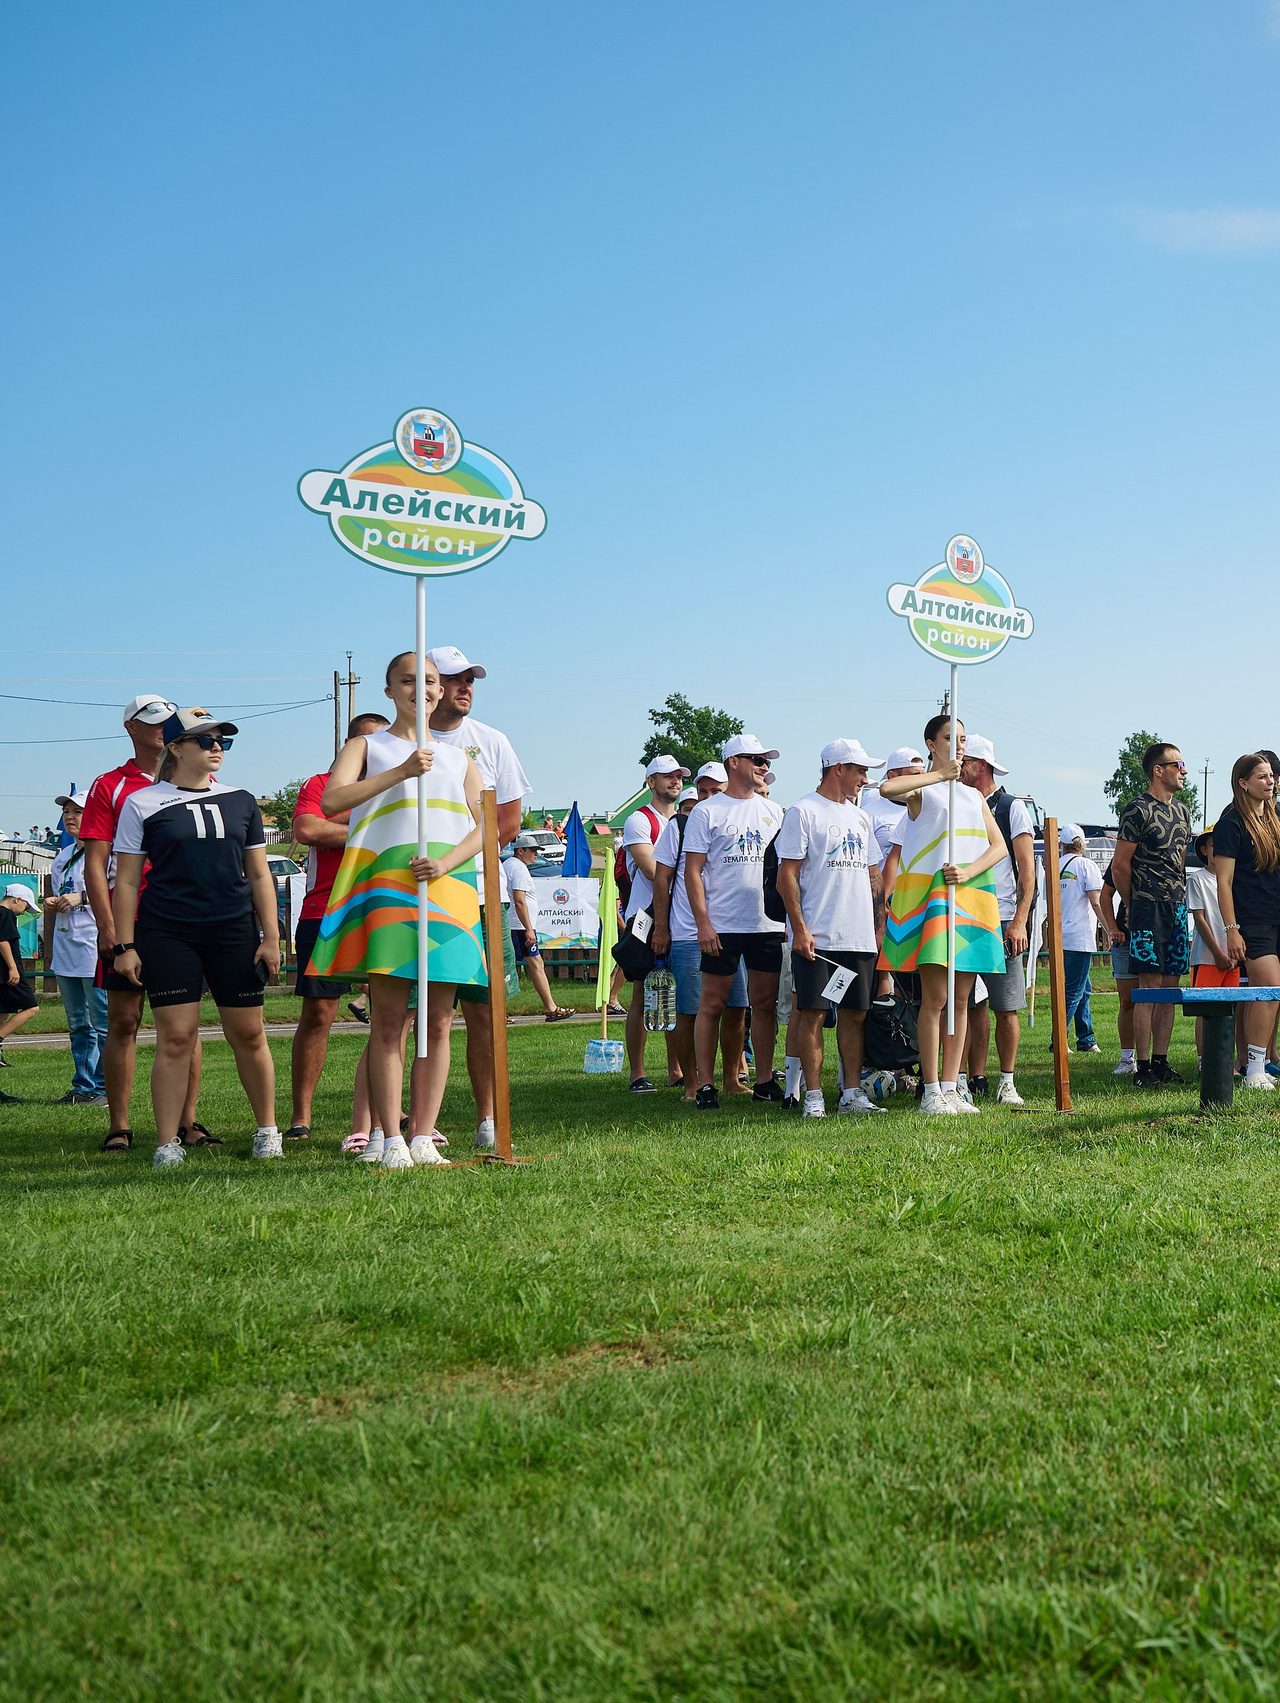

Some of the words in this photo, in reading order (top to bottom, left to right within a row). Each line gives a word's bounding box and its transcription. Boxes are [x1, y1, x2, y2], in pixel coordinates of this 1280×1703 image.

[320, 477, 526, 531] Алейский
[362, 527, 476, 557] район
[900, 589, 1026, 633] Алтайский
[926, 626, 990, 651] район
[185, 803, 226, 839] 11
[723, 855, 748, 864] ЗЕМЛЯ
[827, 860, 851, 868] ЗЕМЛЯ
[537, 908, 584, 917] АЛТАЙСКИЙ
[551, 917, 572, 926] КРАЙ
[530, 943, 537, 953] 6
